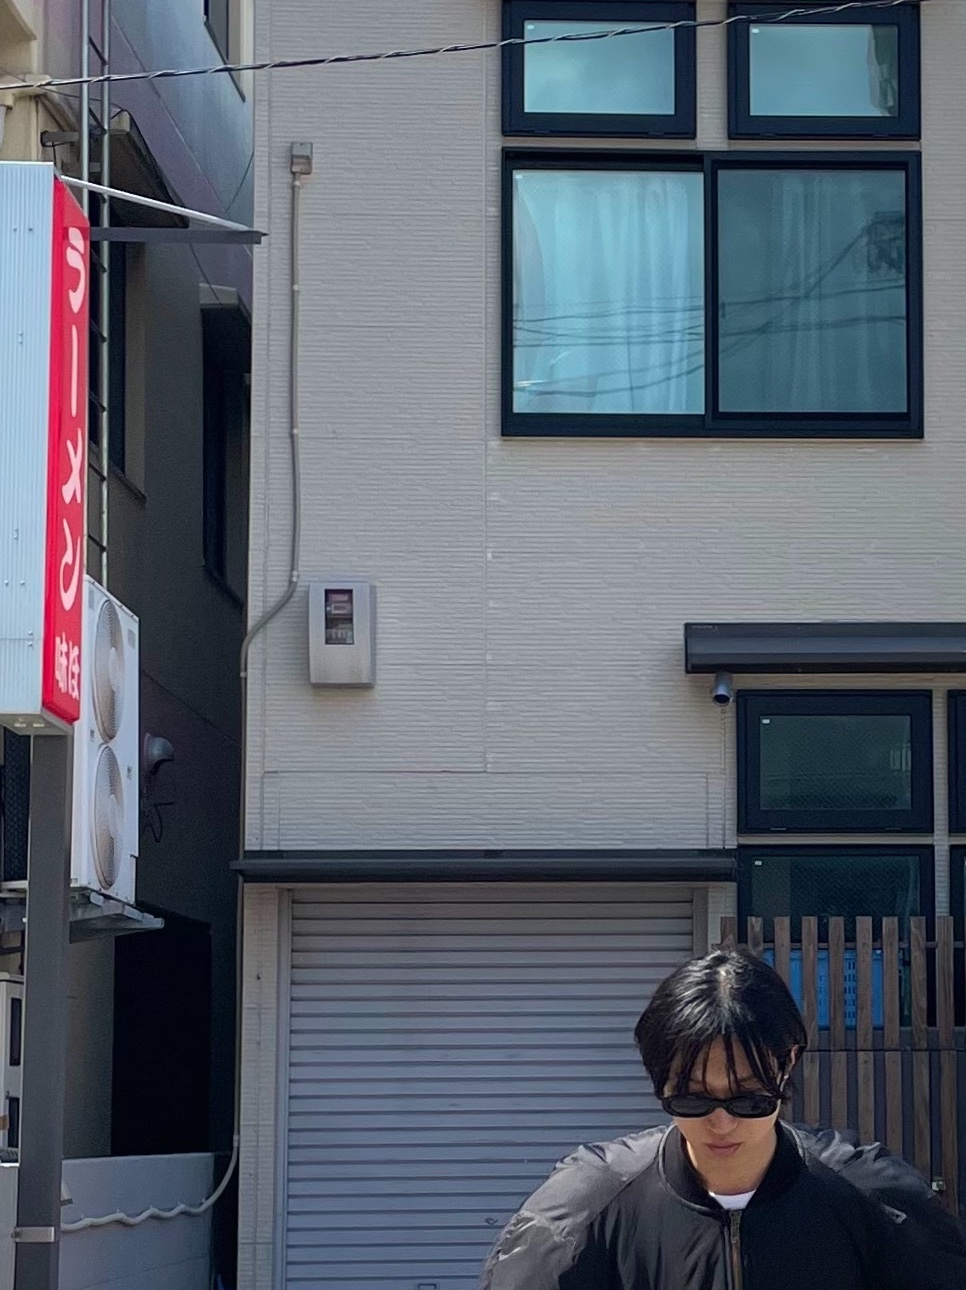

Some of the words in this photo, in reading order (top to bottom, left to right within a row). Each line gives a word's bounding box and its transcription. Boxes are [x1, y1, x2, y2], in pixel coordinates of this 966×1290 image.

[60, 225, 87, 612] ラーメン
[54, 632, 81, 700] 味ほ
